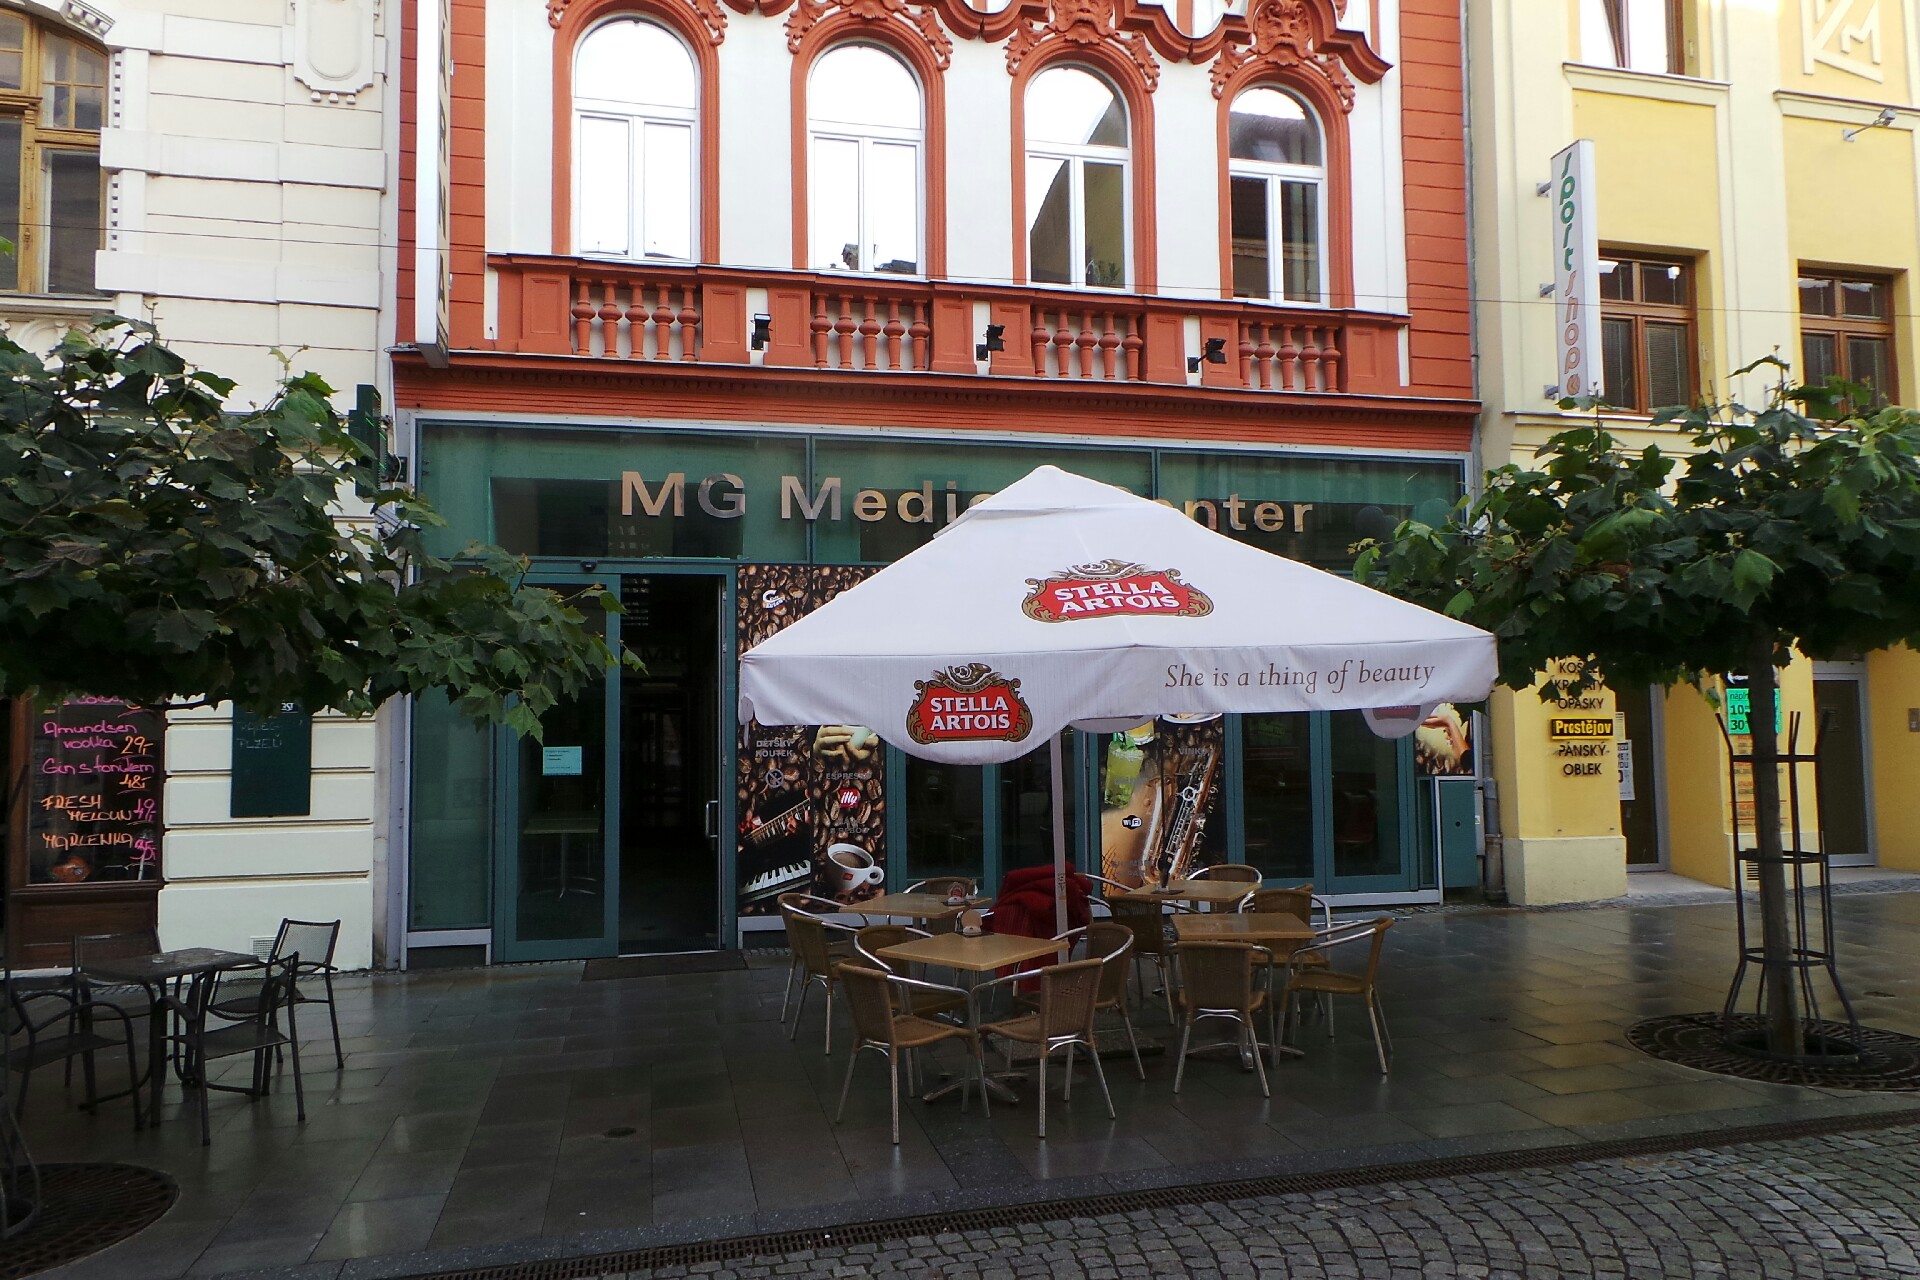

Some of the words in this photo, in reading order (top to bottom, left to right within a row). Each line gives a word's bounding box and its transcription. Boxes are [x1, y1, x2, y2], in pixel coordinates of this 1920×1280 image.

[622, 471, 746, 518] MG
[1054, 581, 1171, 601] STELLA
[1061, 595, 1180, 613] ARTOIS
[1165, 663, 1205, 688] She
[1213, 667, 1229, 687] is
[1237, 671, 1250, 687] a
[1258, 662, 1318, 694] thing
[1327, 659, 1353, 693] of
[1358, 660, 1436, 689] beauty
[931, 696, 1009, 713] STELLA
[1557, 697, 1604, 710] OPASKY
[43, 720, 137, 738] Amundsen
[930, 714, 1010, 731] ARTOIS
[1555, 719, 1612, 736] Prostějov
[63, 736, 117, 749] vodka
[42, 757, 76, 775] Gin
[1563, 763, 1602, 776] OBLEK
[40, 794, 101, 810] FRESH
